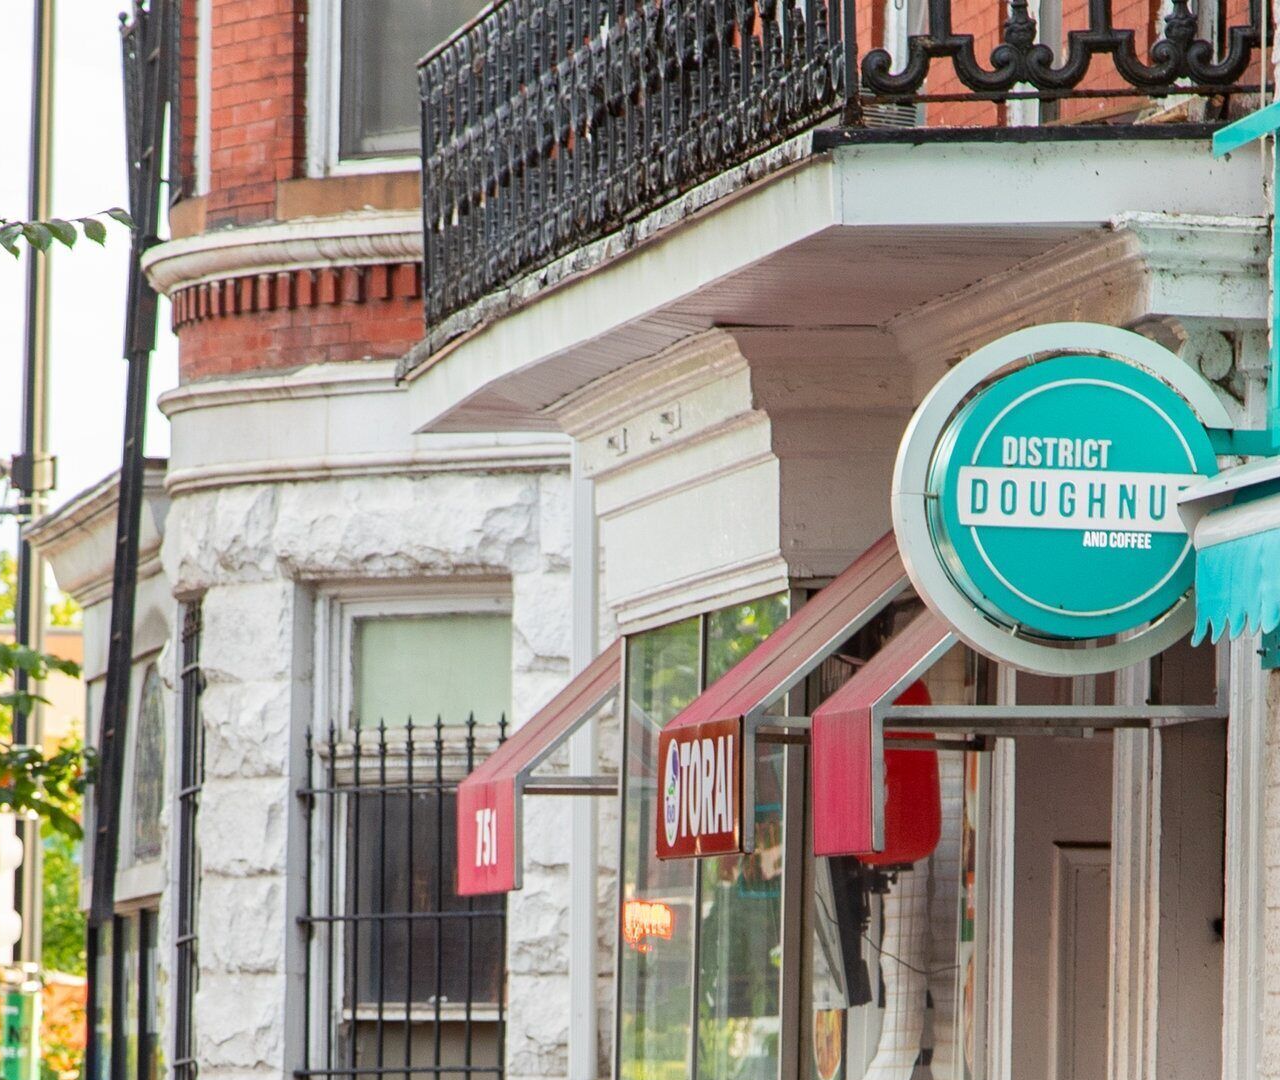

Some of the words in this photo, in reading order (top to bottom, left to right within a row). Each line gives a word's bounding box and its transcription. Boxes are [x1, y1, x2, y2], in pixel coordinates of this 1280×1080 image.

[1002, 436, 1112, 469] DISTRICT
[971, 478, 1190, 521] DOUGHNU
[1083, 531, 1108, 549] AND
[1109, 532, 1152, 550] COFFEE
[680, 734, 734, 838] TORAI
[476, 808, 497, 867] 751
